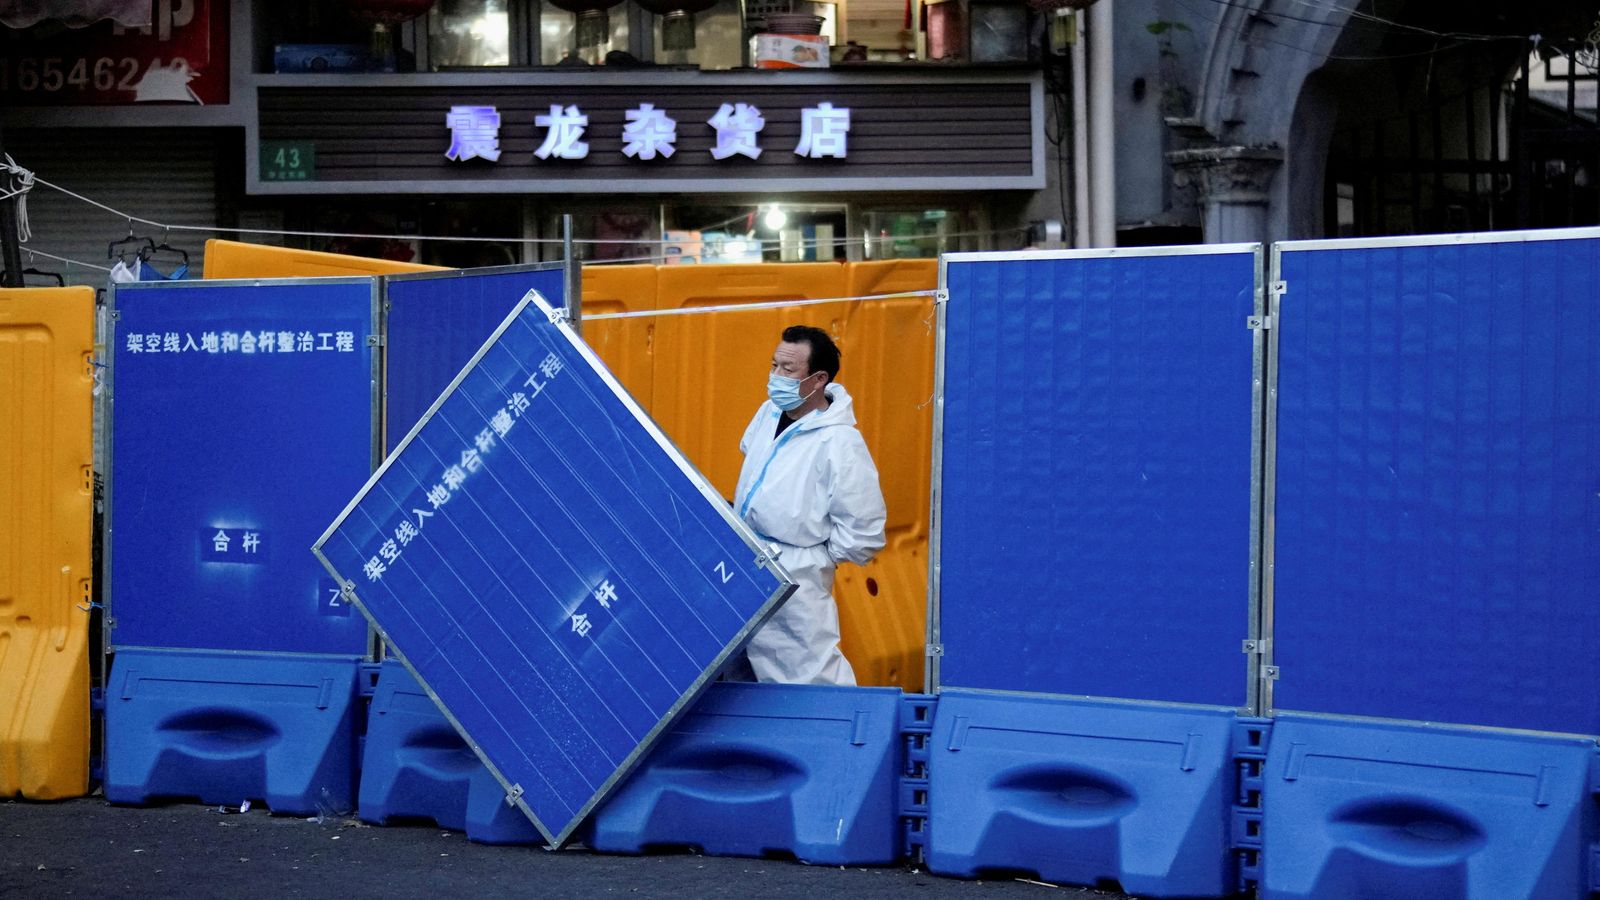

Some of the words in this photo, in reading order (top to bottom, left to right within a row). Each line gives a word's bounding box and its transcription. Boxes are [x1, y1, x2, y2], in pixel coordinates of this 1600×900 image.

[445, 102, 850, 162] 震龙杂货店
[275, 148, 300, 169] 43
[126, 330, 354, 354] 架空线入地和合杆整治工程
[362, 351, 565, 582] 架空线入地和合杆整治工程
[212, 529, 261, 554] 合杆
[571, 579, 618, 637] 合杆
